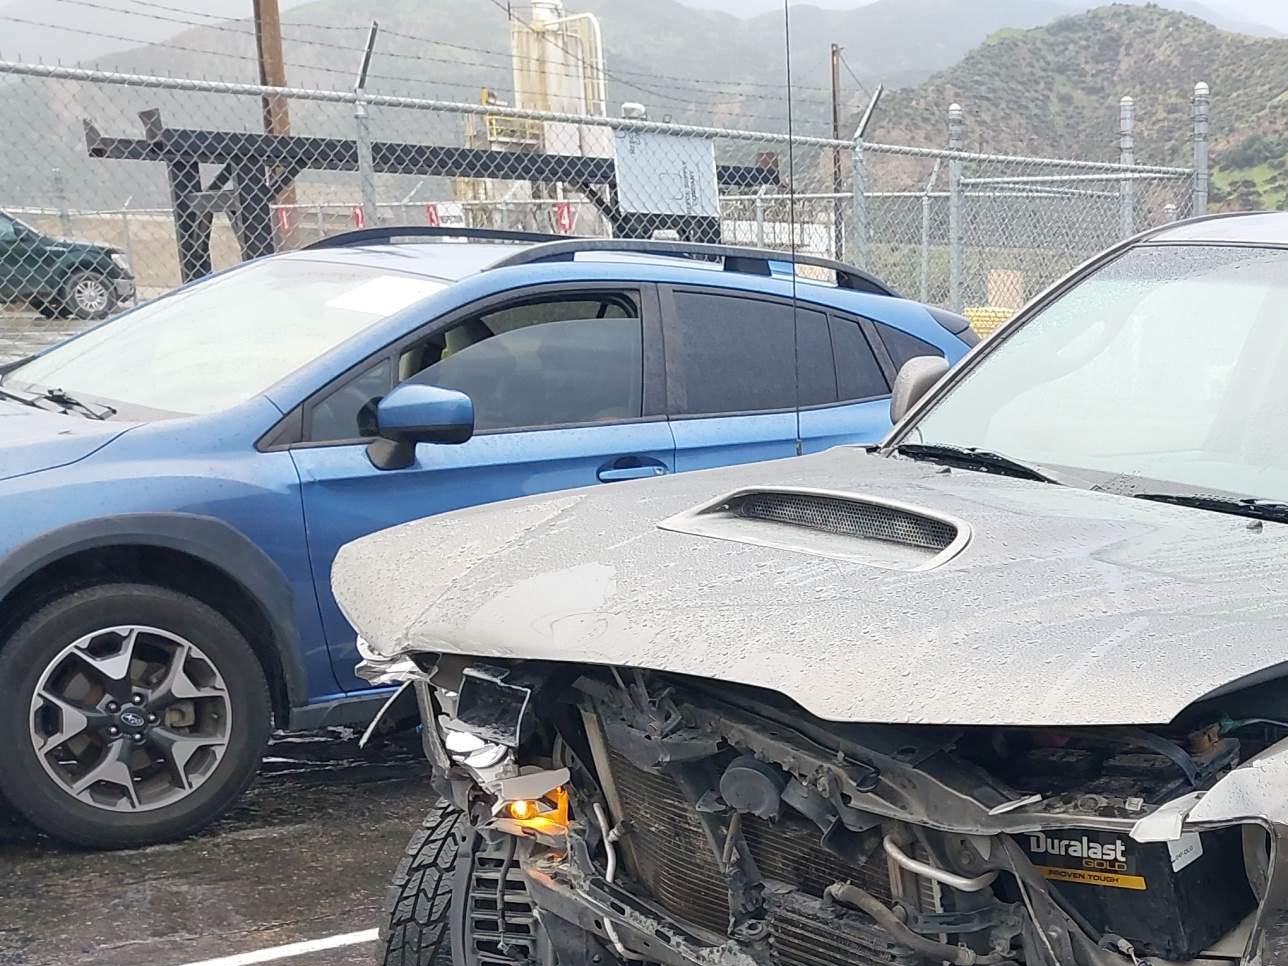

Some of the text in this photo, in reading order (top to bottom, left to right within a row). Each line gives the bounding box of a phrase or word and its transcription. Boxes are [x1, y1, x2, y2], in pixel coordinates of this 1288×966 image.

[1023, 831, 1127, 861] Duralast
[1082, 859, 1128, 871] GOLD
[1048, 869, 1119, 883] PROVEN TOUGH
